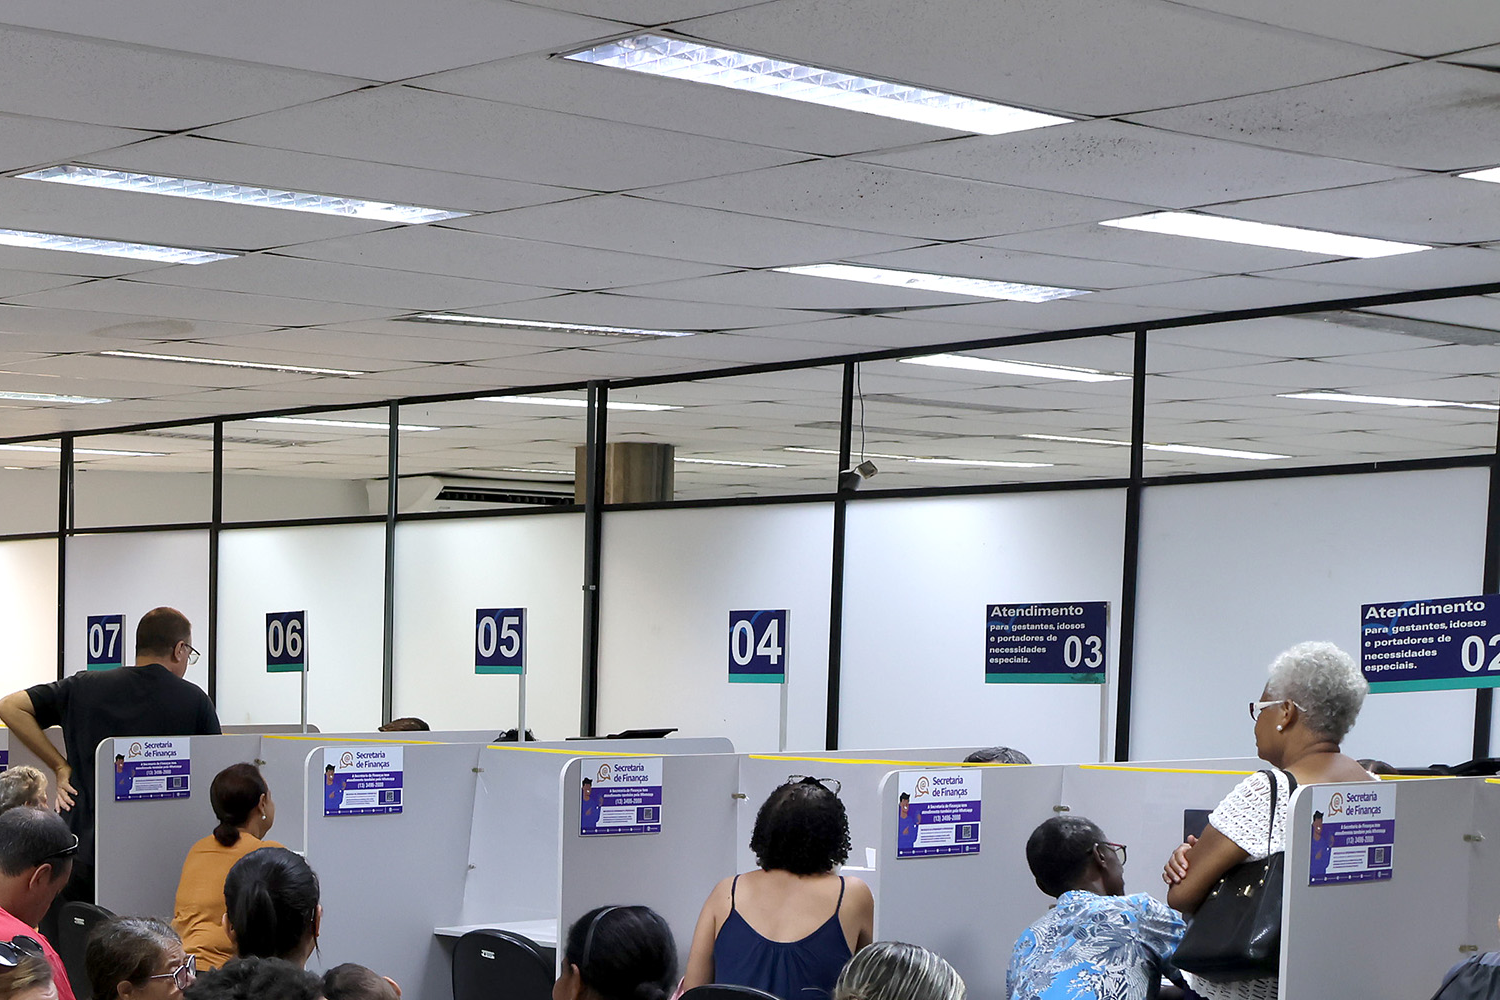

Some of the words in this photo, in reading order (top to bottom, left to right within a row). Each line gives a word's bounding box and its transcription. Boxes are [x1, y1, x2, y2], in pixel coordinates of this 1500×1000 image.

[991, 605, 1083, 617] Atendimento
[1365, 600, 1485, 619] Atendimento
[990, 624, 1009, 632] para
[1012, 623, 1055, 632] gestantes,
[1057, 622, 1085, 630] idosos
[1365, 626, 1388, 636] para
[1392, 622, 1448, 634] gestantes,
[1450, 620, 1486, 628] idosos
[90, 624, 120, 658] 07
[269, 620, 302, 657] 06
[478, 616, 519, 657] 05
[732, 619, 782, 665] 04
[998, 635, 1044, 643] portadores
[1374, 636, 1434, 648] portadores
[1064, 636, 1102, 668] 03
[1365, 649, 1437, 660] necessidades
[990, 656, 1030, 664] especiais.
[1365, 661, 1417, 672] especiais.
[145, 741, 172, 749] Secretaria
[153, 750, 176, 758] Finanças
[356, 751, 385, 759] Secretaria
[365, 760, 389, 769] Finanças
[614, 763, 644, 772] Secretaria
[614, 774, 622, 782] de
[623, 774, 648, 783] Finanças
[933, 775, 963, 785] Secretaria
[932, 788, 940, 796] de
[941, 787, 968, 798] Finanças
[1347, 791, 1377, 802] Secretaria
[1346, 806, 1354, 815] de
[1355, 805, 1381, 817] Finanças
